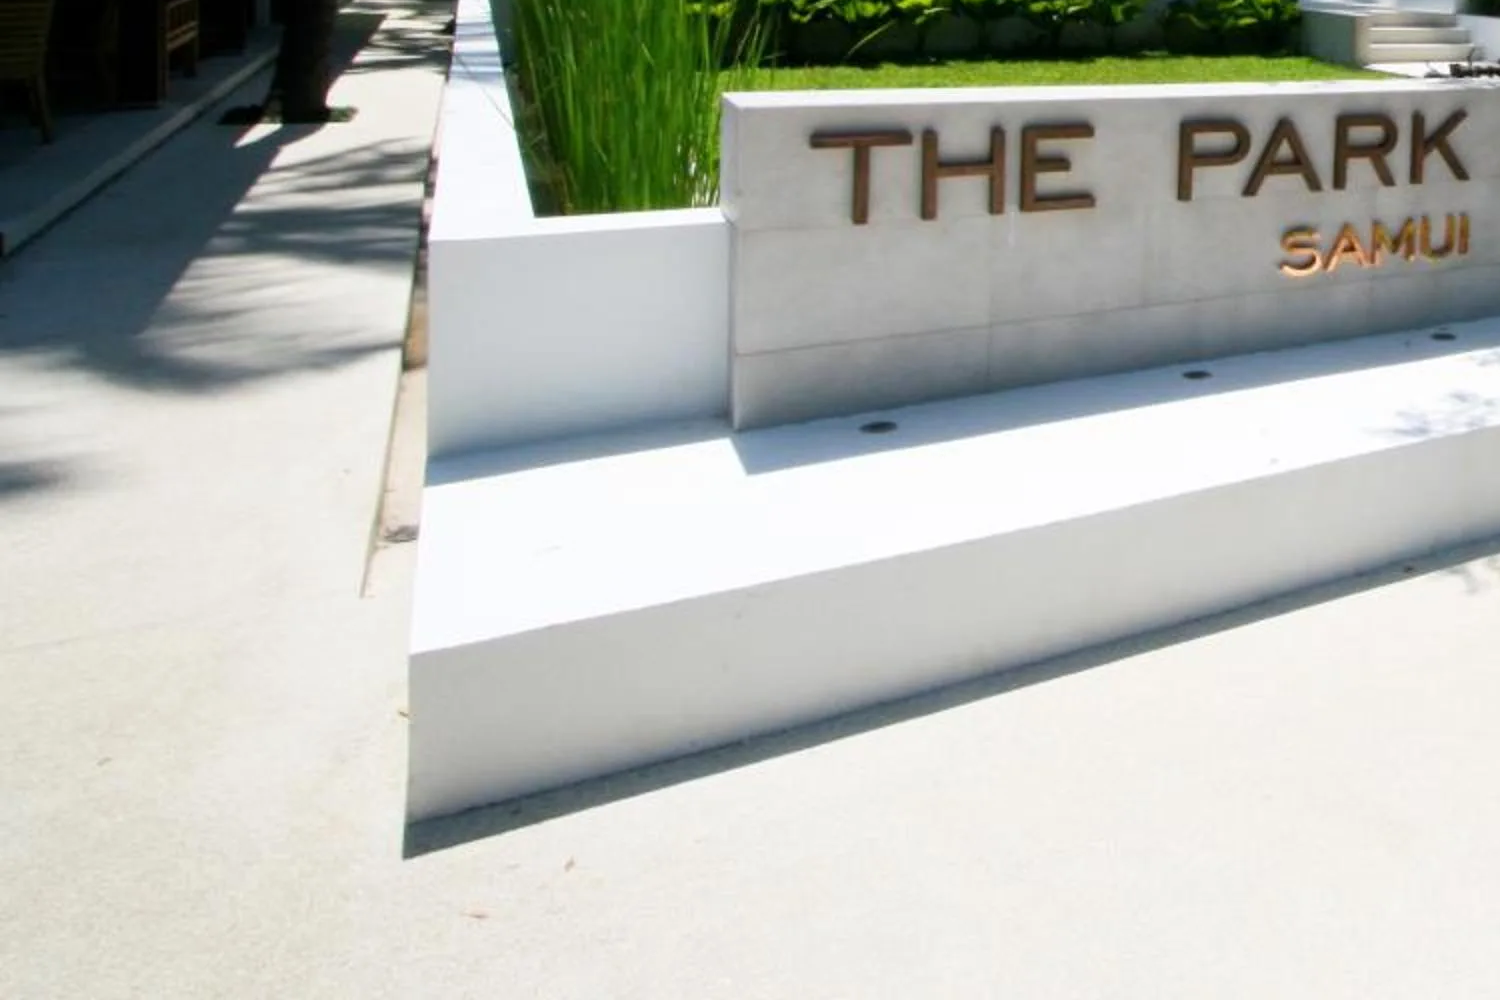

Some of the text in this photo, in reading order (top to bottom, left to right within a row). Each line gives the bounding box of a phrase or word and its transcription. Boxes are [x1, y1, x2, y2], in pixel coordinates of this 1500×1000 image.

[809, 108, 1471, 225] THE PARK
[1277, 211, 1472, 279] SAMUI
